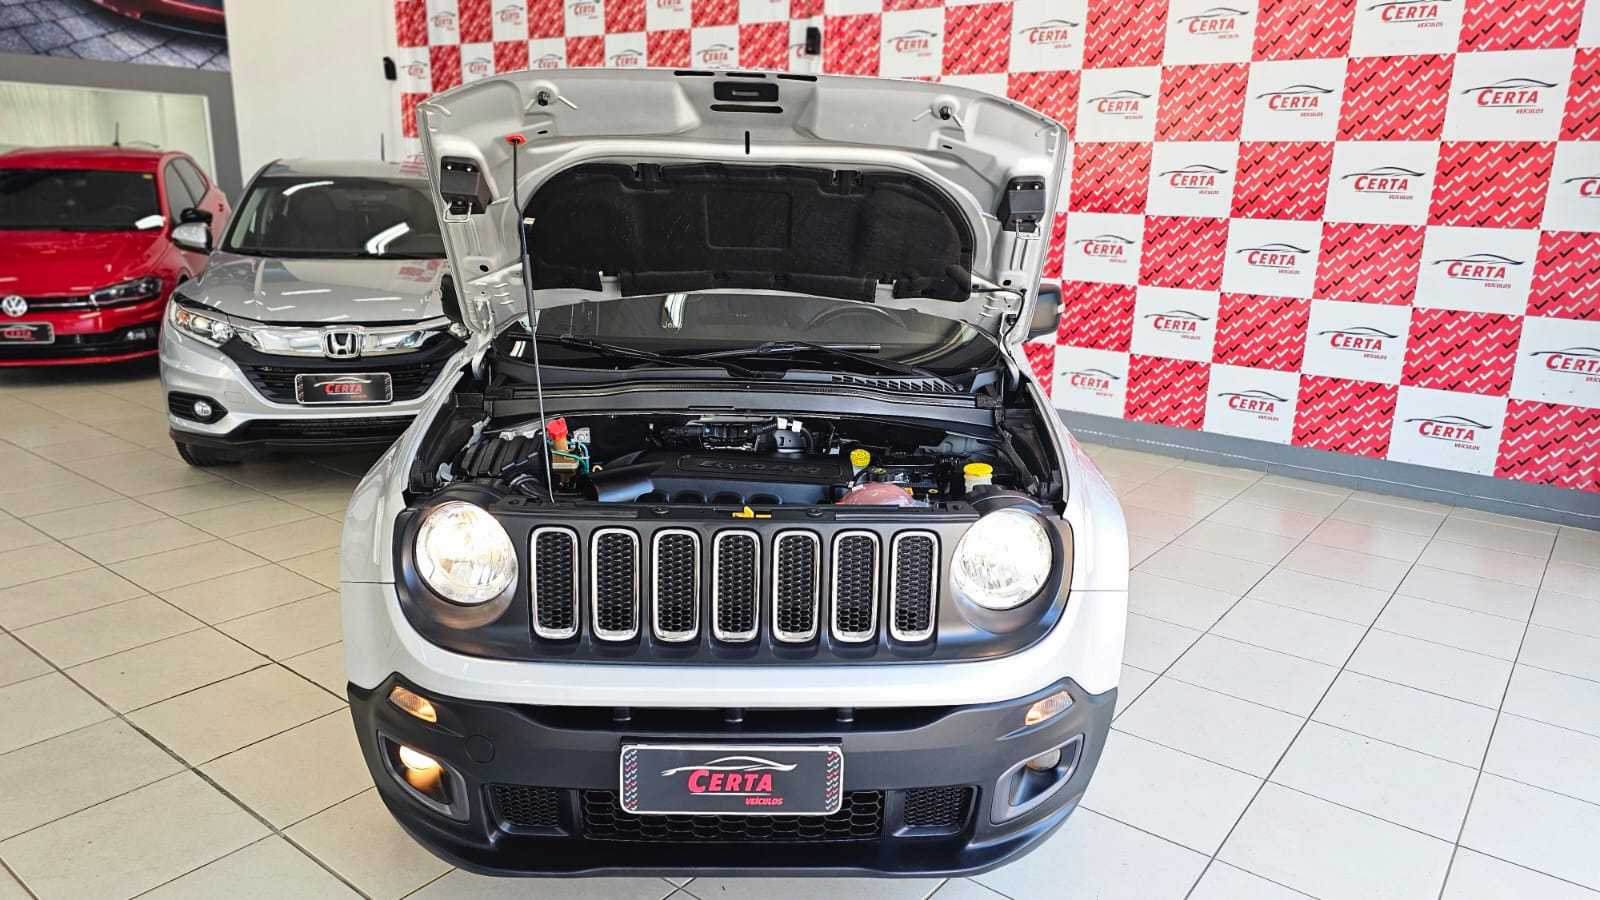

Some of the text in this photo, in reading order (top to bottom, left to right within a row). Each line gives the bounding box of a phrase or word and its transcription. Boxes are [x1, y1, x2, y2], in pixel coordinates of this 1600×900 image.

[1381, 5, 1438, 21] CERTA
[1189, 18, 1235, 33] CERTA
[1029, 27, 1068, 44] CERTA
[896, 38, 929, 52] CERTA
[1268, 95, 1319, 109] CERTA
[1476, 90, 1539, 105] CERTA
[1097, 100, 1139, 112] CERTA
[1170, 173, 1215, 187] CERTA
[1354, 175, 1409, 190] CERTA
[1084, 242, 1123, 255] CERTA
[1248, 251, 1295, 266] CERTA
[1447, 262, 1506, 278] CERTA
[1153, 317, 1197, 331] CERTA
[1330, 333, 1382, 350] CERTA
[323, 383, 363, 394] CERTA
[1071, 375, 1109, 389] CERTA
[1228, 396, 1274, 413] CERTA
[1419, 422, 1475, 441] CERTA
[688, 768, 773, 793] CERTA
